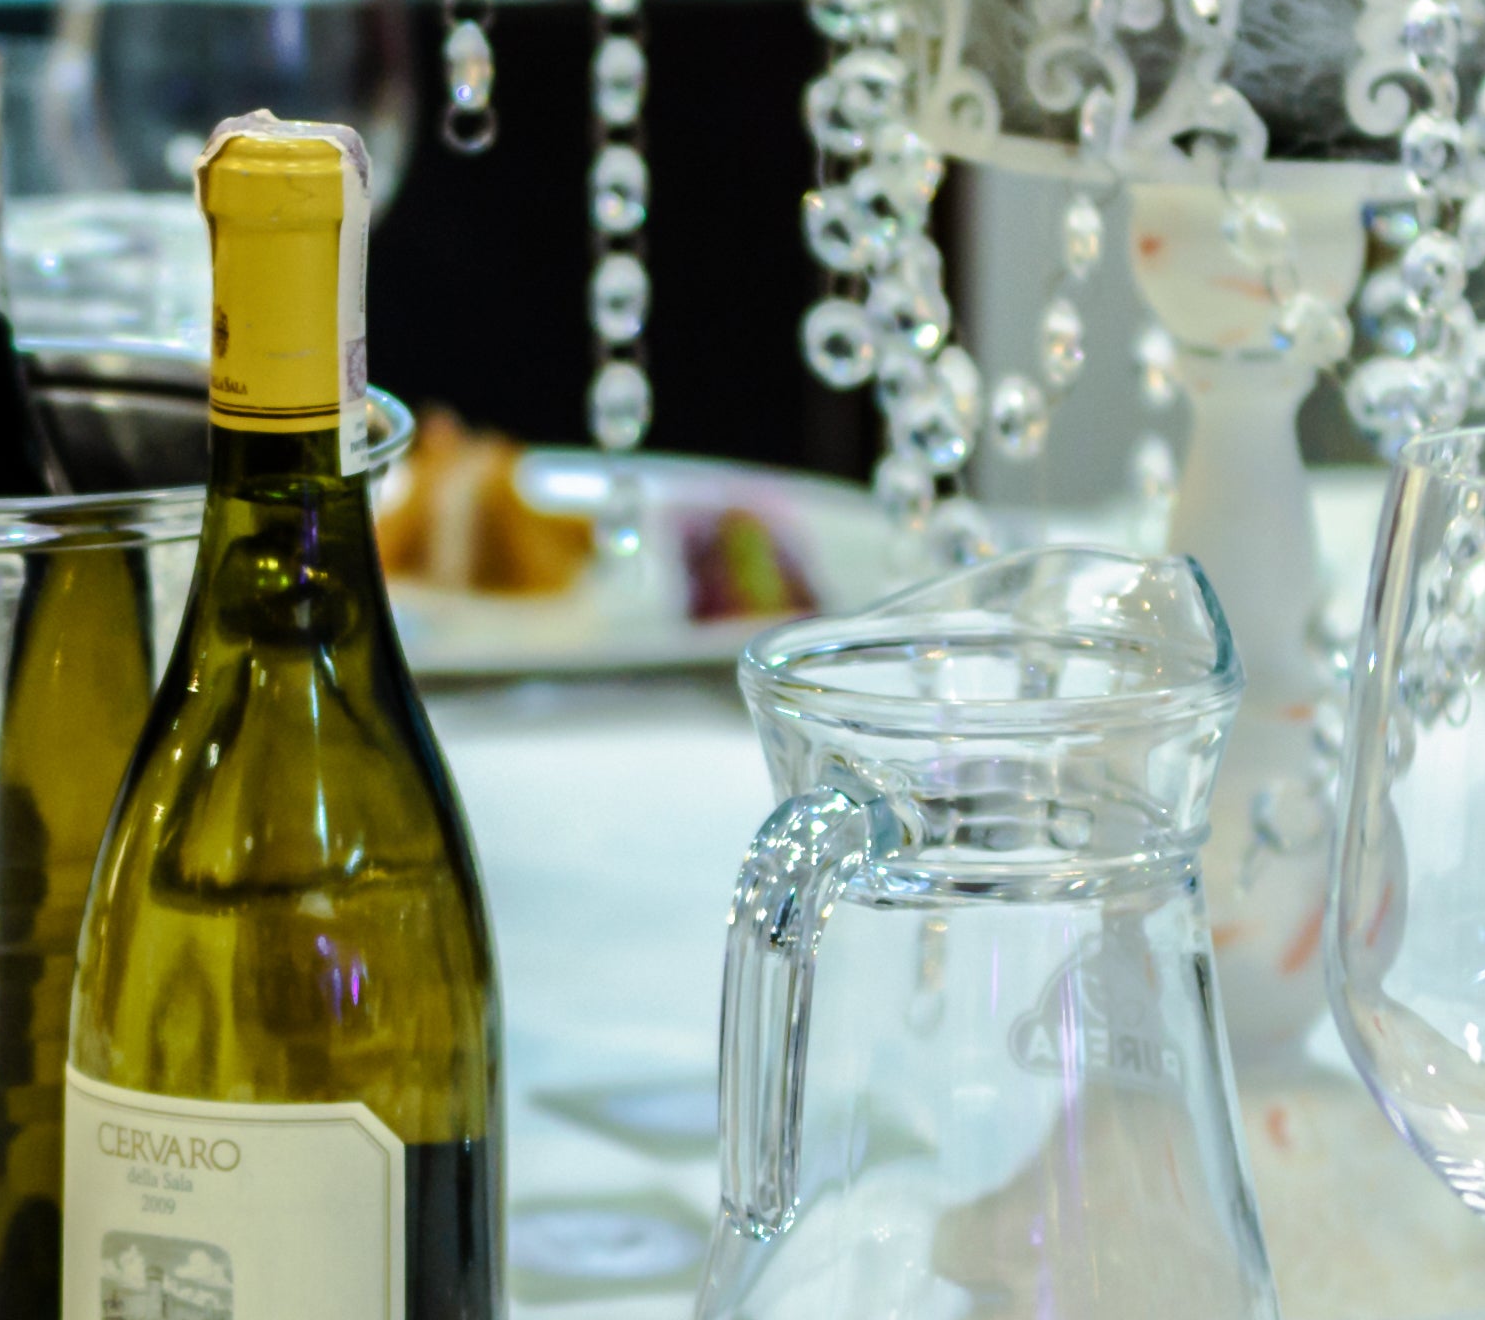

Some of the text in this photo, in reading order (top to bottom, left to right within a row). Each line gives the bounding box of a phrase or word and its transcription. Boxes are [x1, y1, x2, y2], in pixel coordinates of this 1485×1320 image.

[97, 1121, 241, 1172] CERVARO
[127, 1166, 194, 1192] della Sala
[141, 1193, 177, 1215] 2009
